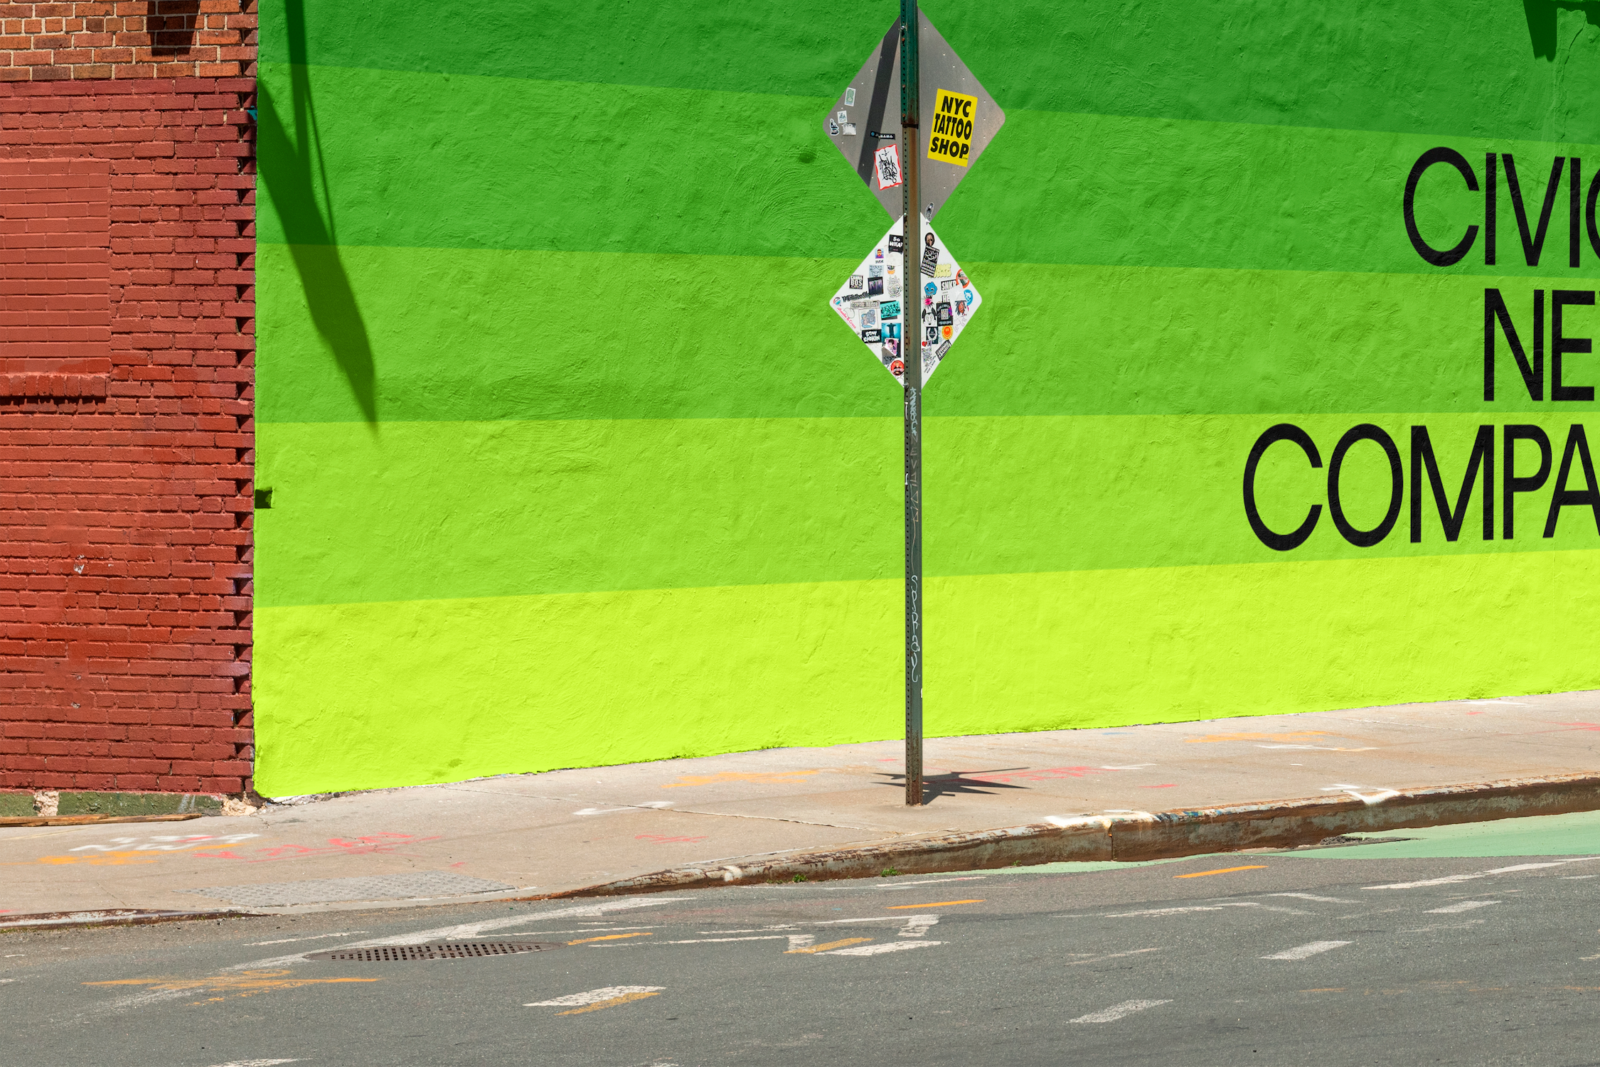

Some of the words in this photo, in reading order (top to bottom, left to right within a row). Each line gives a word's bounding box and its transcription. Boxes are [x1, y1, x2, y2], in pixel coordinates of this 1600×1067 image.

[940, 95, 972, 117] NYC
[933, 113, 972, 140] TATTOO
[930, 136, 970, 159] SHOP
